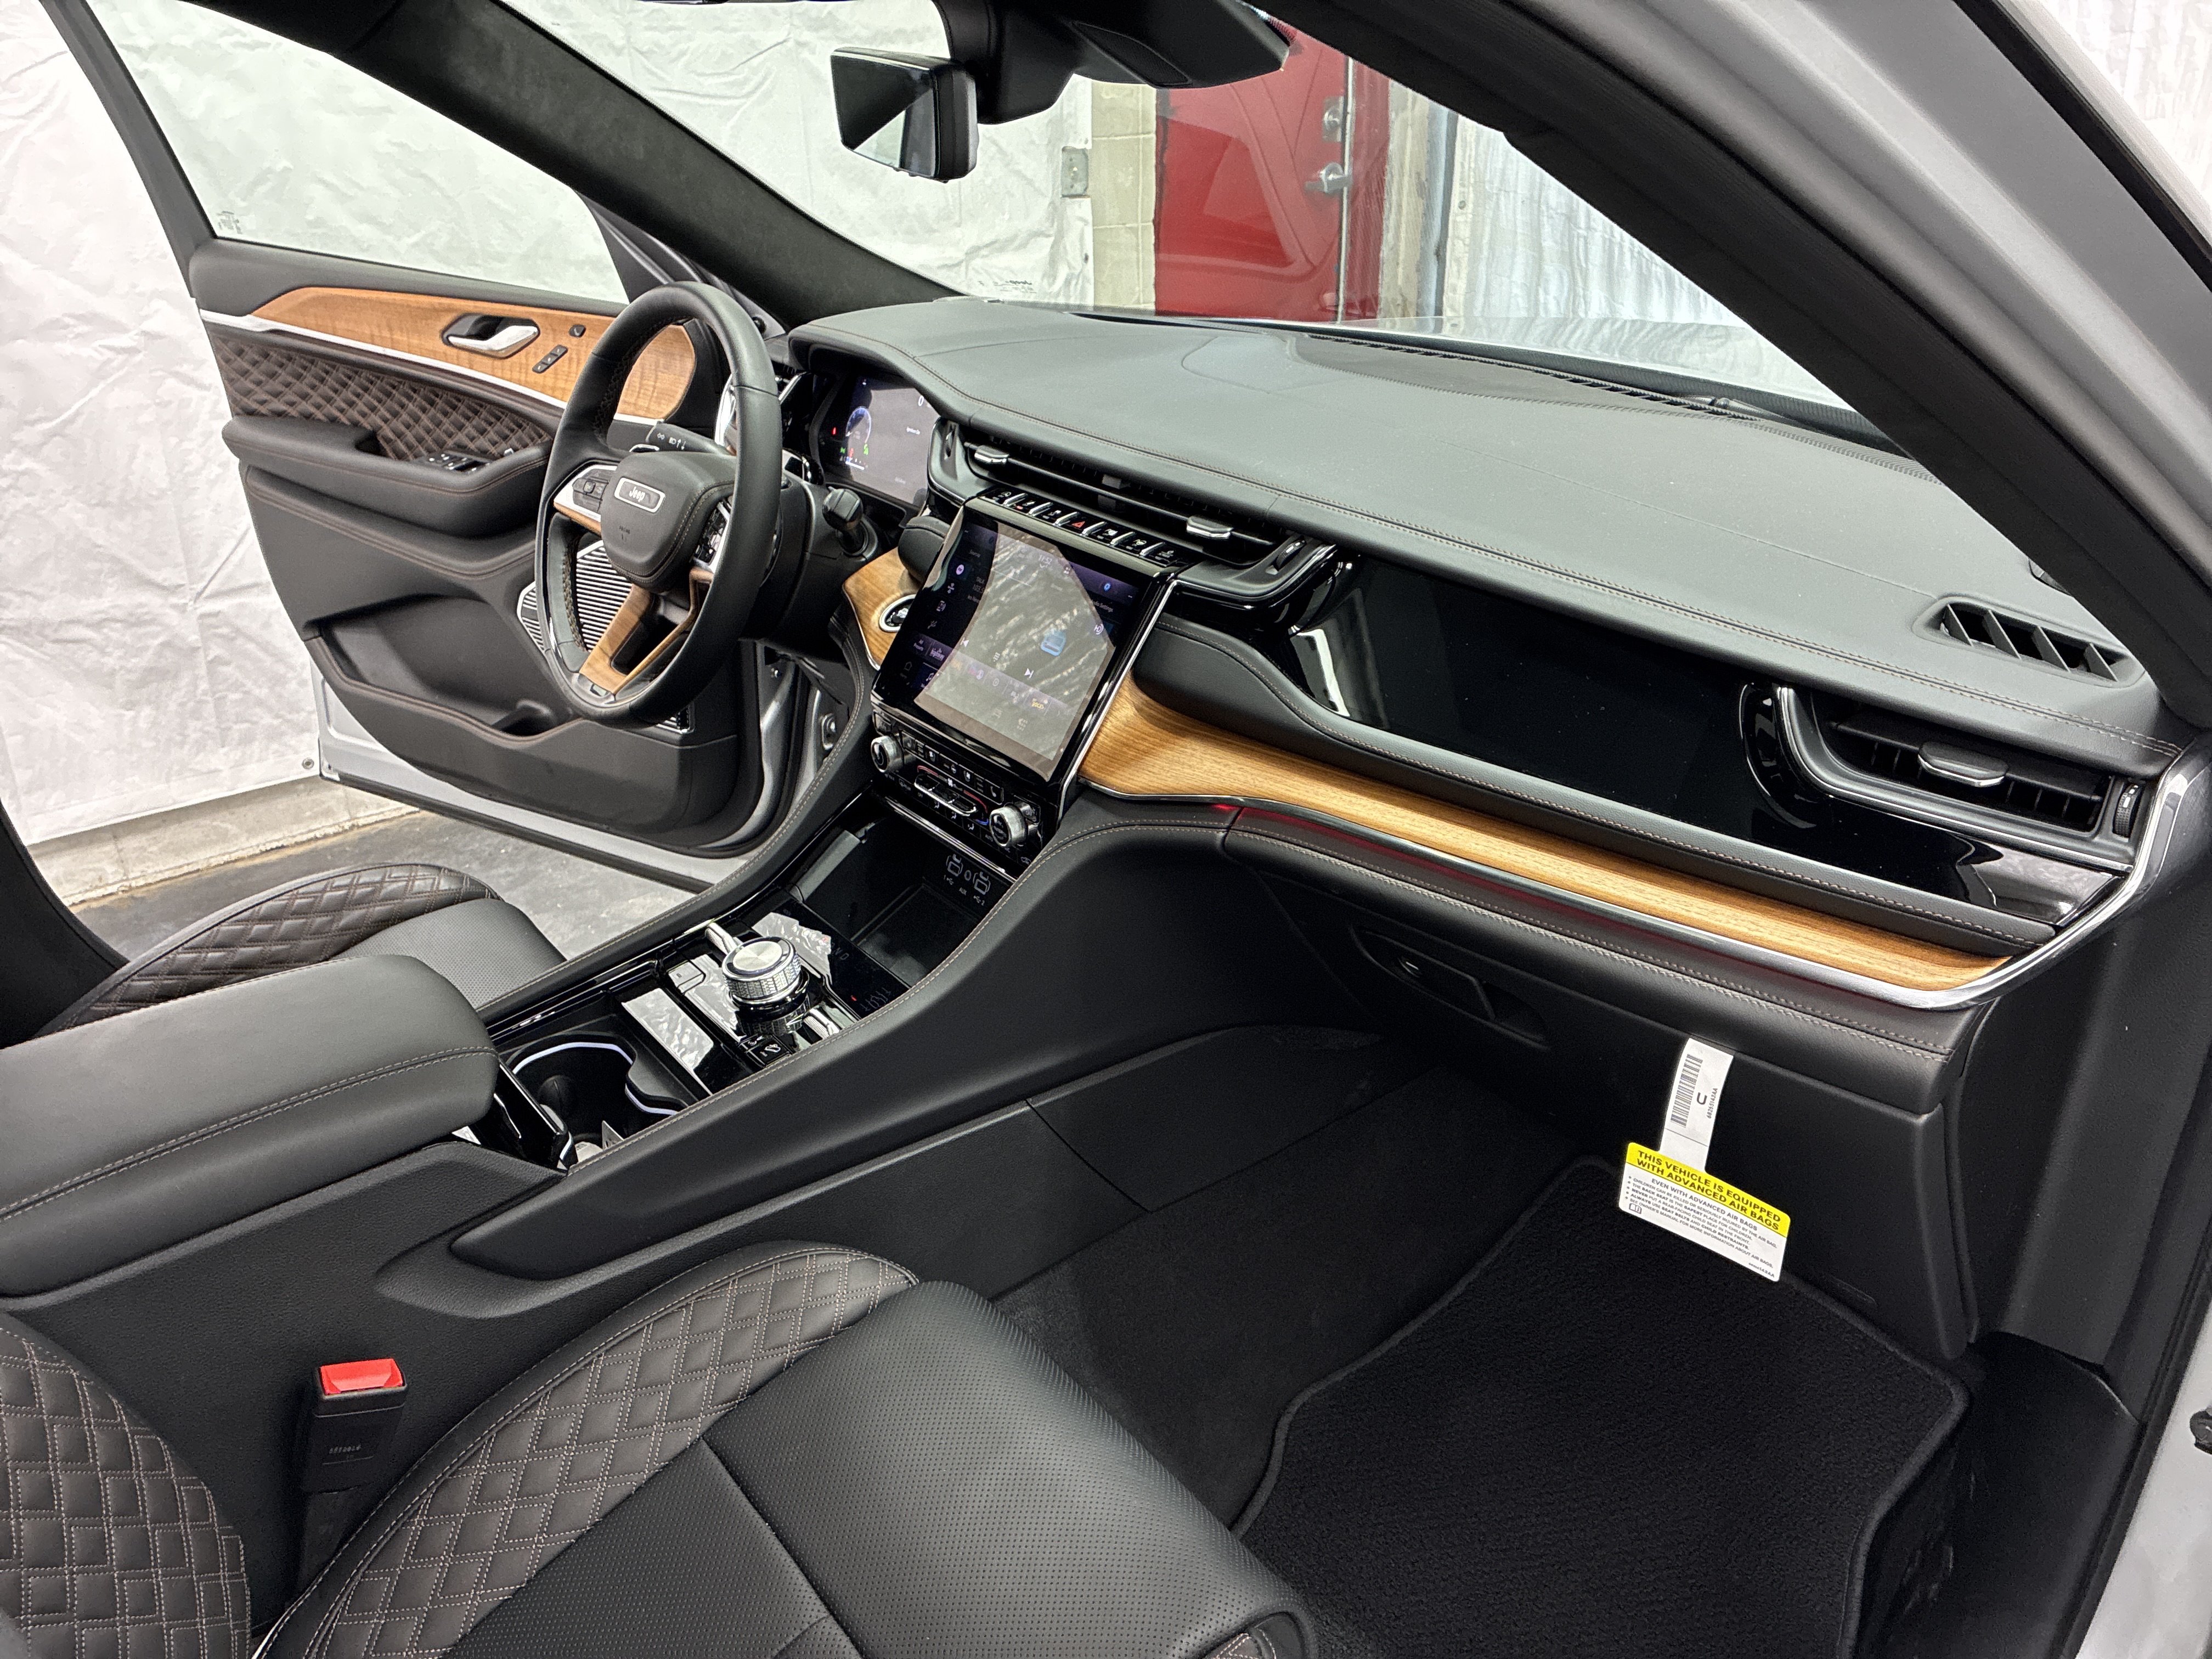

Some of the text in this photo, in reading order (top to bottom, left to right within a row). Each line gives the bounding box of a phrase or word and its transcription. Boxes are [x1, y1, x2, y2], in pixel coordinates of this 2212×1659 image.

[629, 487, 645, 502] Jeep
[1696, 1092, 1707, 1105] U
[1632, 1188, 1647, 1198] NEVER
[1662, 1201, 1691, 1216] REAR-FACING
[1691, 1214, 1706, 1223] CHILD
[1633, 1177, 1655, 1190] CHILDREN
[1673, 1194, 1689, 1204] KILLED
[1696, 1205, 1721, 1220] SERIOUSLY
[1722, 1217, 1741, 1229] INJURED
[1636, 1158, 1779, 1231] WITH ADVANCED AIR BAGS
[1637, 1149, 1781, 1223] THIS VEHICLE IS EQUIPPED
[1641, 1186, 1655, 1195] BACK
[1656, 1193, 1668, 1201] SEAT
[1684, 1205, 1702, 1216] SAFEST
[1703, 1214, 1718, 1223] PLACE
[1651, 1177, 1757, 1231] EVEN WITH ADVANCED AIR BAGS
[1630, 1192, 1651, 1204] ALWAYS
[1661, 1206, 1674, 1215] SEAT
[1674, 1212, 1690, 1221] BELTS
[1701, 1223, 1717, 1234] CHILD
[1660, 1211, 1679, 1222] MANUAL
[1689, 1223, 1703, 1233] MORE
[1703, 1230, 1734, 1248] INFORMATION
[1735, 1245, 1751, 1256] ABOUT
